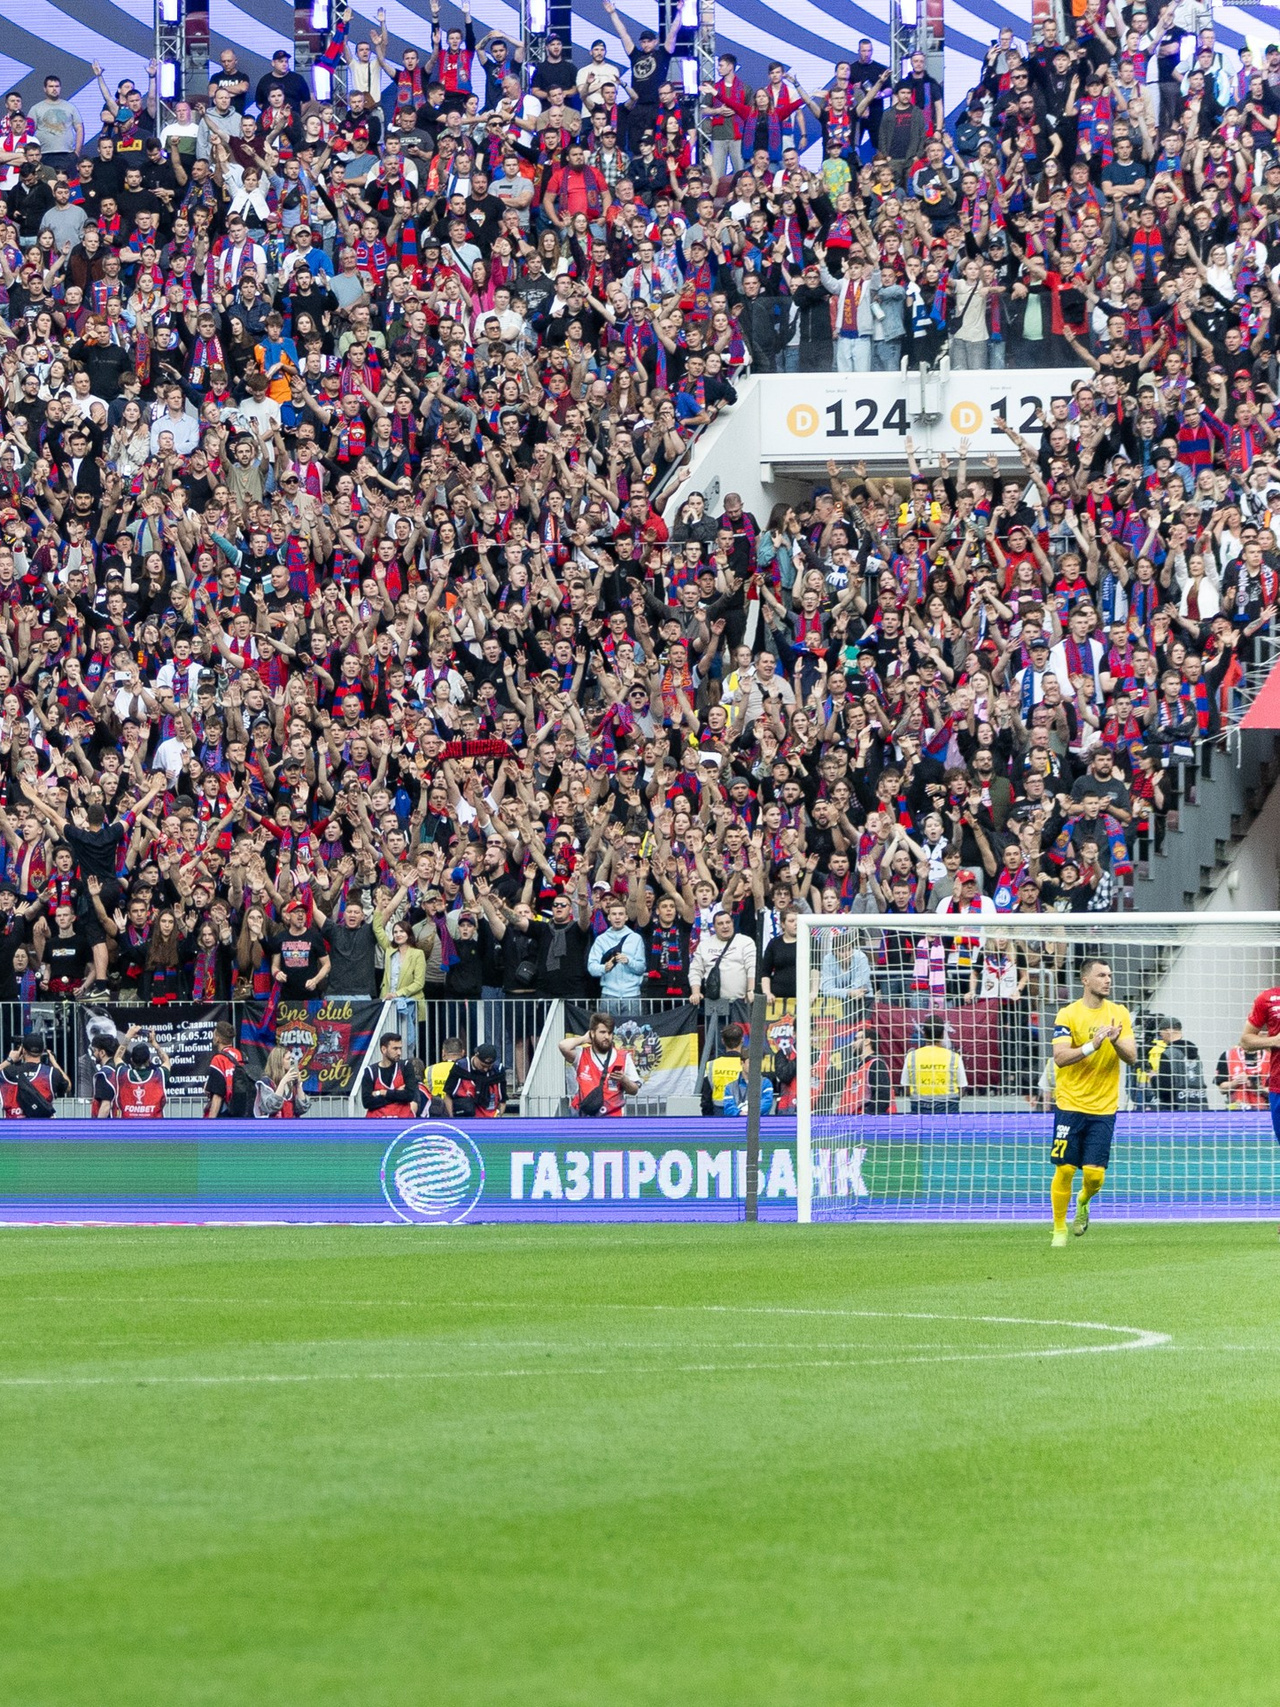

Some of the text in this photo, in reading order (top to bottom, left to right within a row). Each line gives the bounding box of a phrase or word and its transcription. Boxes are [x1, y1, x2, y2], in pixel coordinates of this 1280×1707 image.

[796, 399, 911, 437] D 124
[960, 408, 972, 427] D
[276, 1000, 353, 1020] One club
[280, 1029, 314, 1046] ЦСКА
[177, 1042, 213, 1053] Любим!
[319, 1059, 354, 1087] city
[123, 1103, 156, 1114] FONBET
[1051, 1139, 1068, 1158] 27
